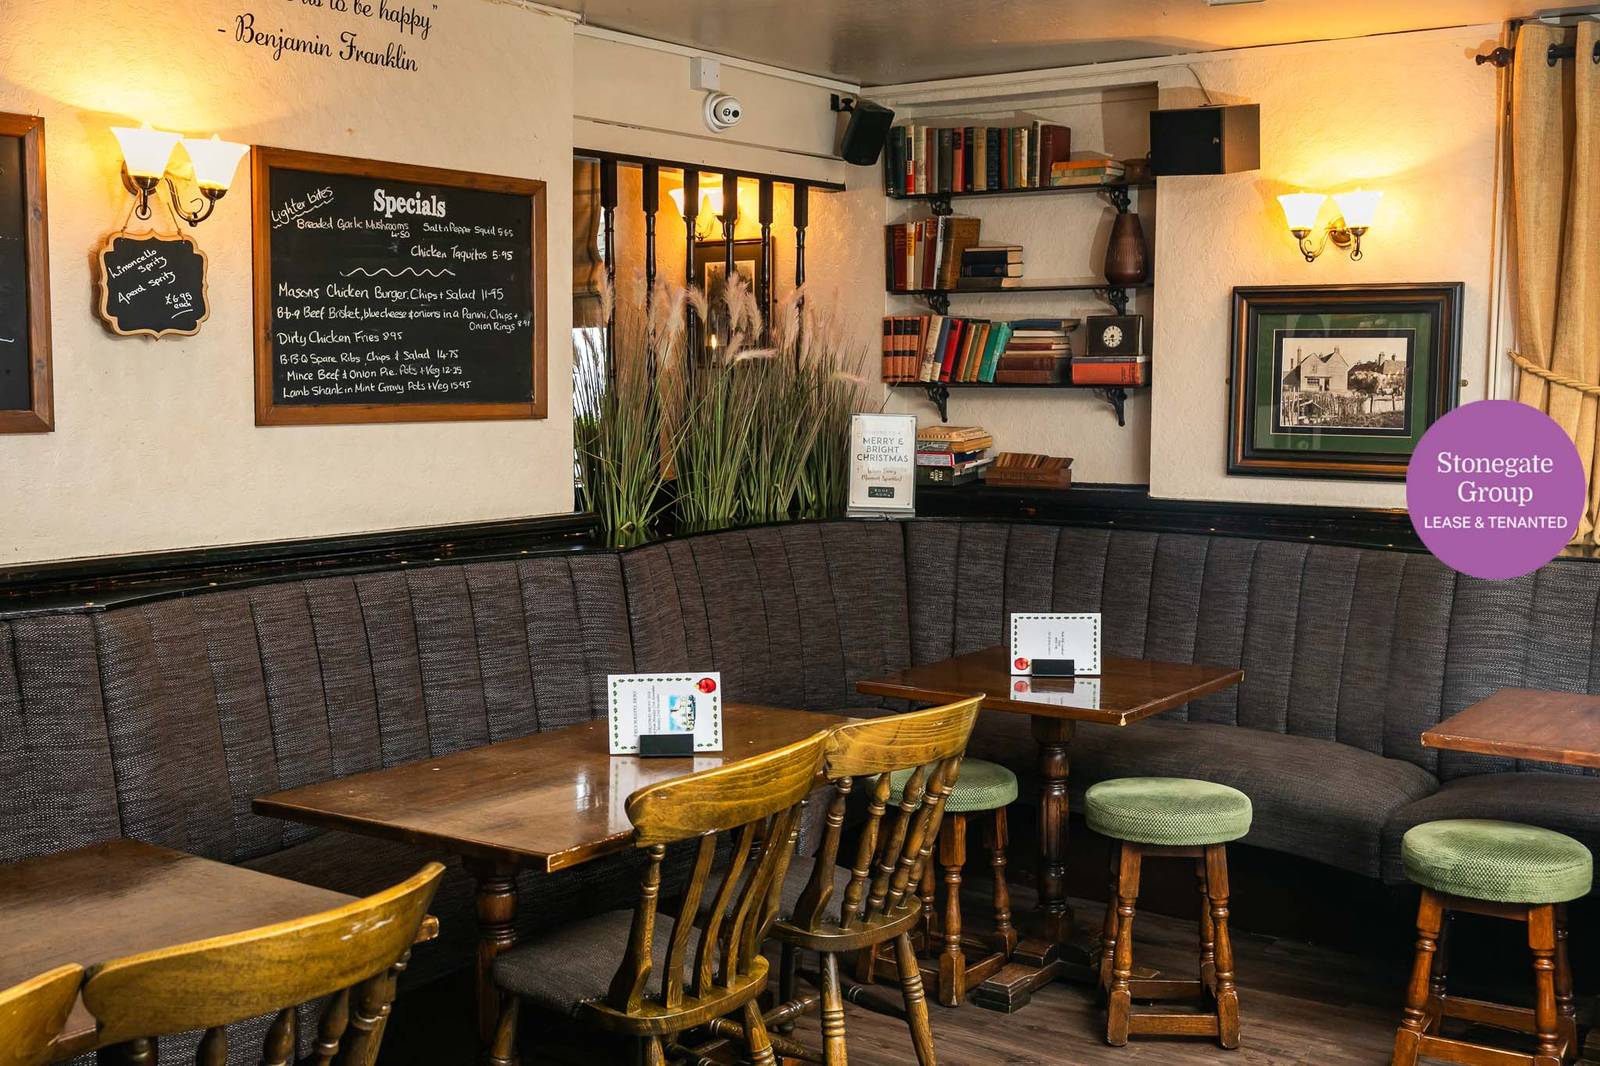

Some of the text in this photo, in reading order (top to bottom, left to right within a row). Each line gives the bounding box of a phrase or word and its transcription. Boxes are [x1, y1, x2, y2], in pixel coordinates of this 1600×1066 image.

[330, 0, 348, 12] to
[353, 0, 373, 17] be
[235, 13, 332, 61] Benjamin
[339, 31, 418, 72] Franklin
[306, 186, 333, 204] bites
[373, 188, 446, 218] Specials
[296, 216, 334, 230] Breaded
[337, 216, 363, 231] Garlic
[474, 225, 496, 237] Squid
[410, 244, 447, 259] Chicken
[450, 244, 489, 262] Taquitos
[278, 282, 320, 299] Masons
[326, 283, 370, 299] Chicken
[445, 288, 476, 300] Salad
[173, 301, 192, 310] each
[303, 305, 325, 320] Beef
[489, 308, 513, 321] Chips
[469, 321, 492, 331] Onion
[493, 321, 516, 334] Rings
[276, 330, 307, 347] Dirty
[308, 329, 351, 344] Chicken
[352, 330, 380, 343] Fries
[309, 352, 338, 366] Spare
[403, 348, 431, 361] Salad
[287, 369, 314, 382] Mince
[317, 368, 340, 381] Beef
[349, 368, 377, 379] Onion
[283, 386, 310, 399] Lamb
[311, 382, 343, 396] Shank
[354, 382, 376, 393] Mint
[378, 382, 404, 394] Gravy
[407, 380, 426, 391] Pots
[432, 379, 449, 392] Veg
[862, 437, 894, 446] MERRY
[866, 445, 900, 454] BRIGHT
[856, 453, 909, 463] CHRISTMAS
